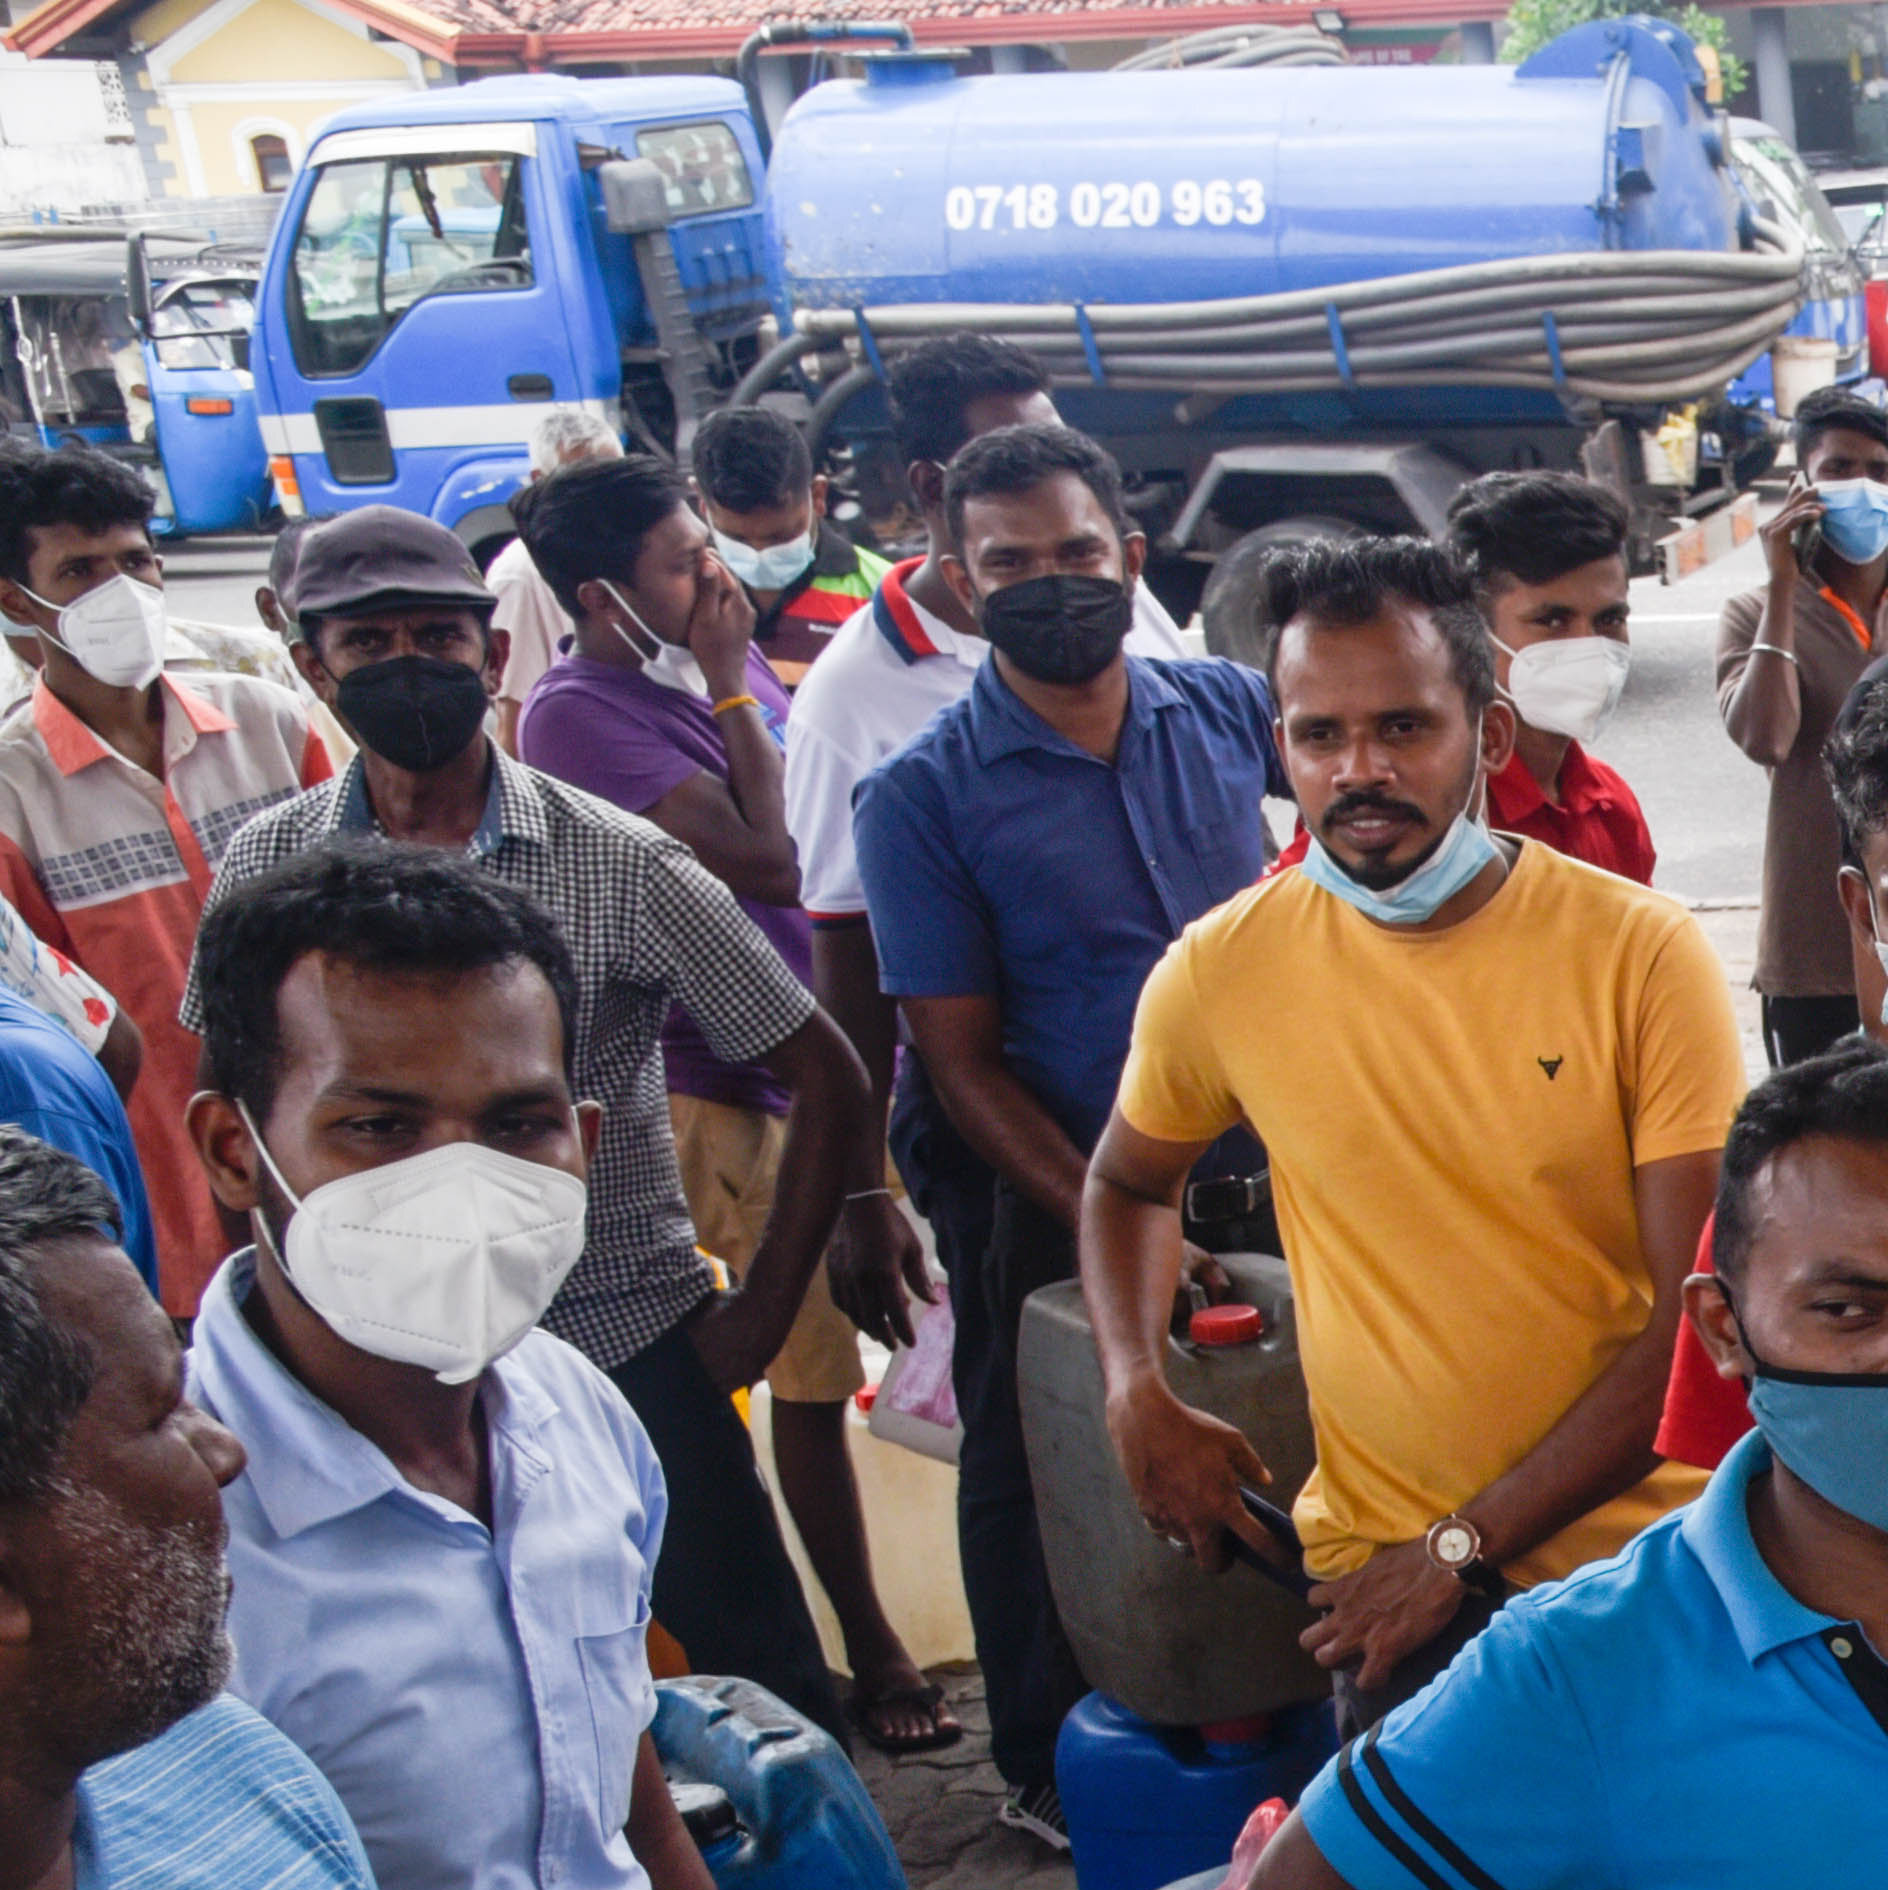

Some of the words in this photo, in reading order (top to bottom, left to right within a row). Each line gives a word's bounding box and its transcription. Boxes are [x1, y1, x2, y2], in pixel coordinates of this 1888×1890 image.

[945, 184, 1059, 231] 0718
[1070, 182, 1161, 228] 020
[1171, 179, 1267, 226] 963
